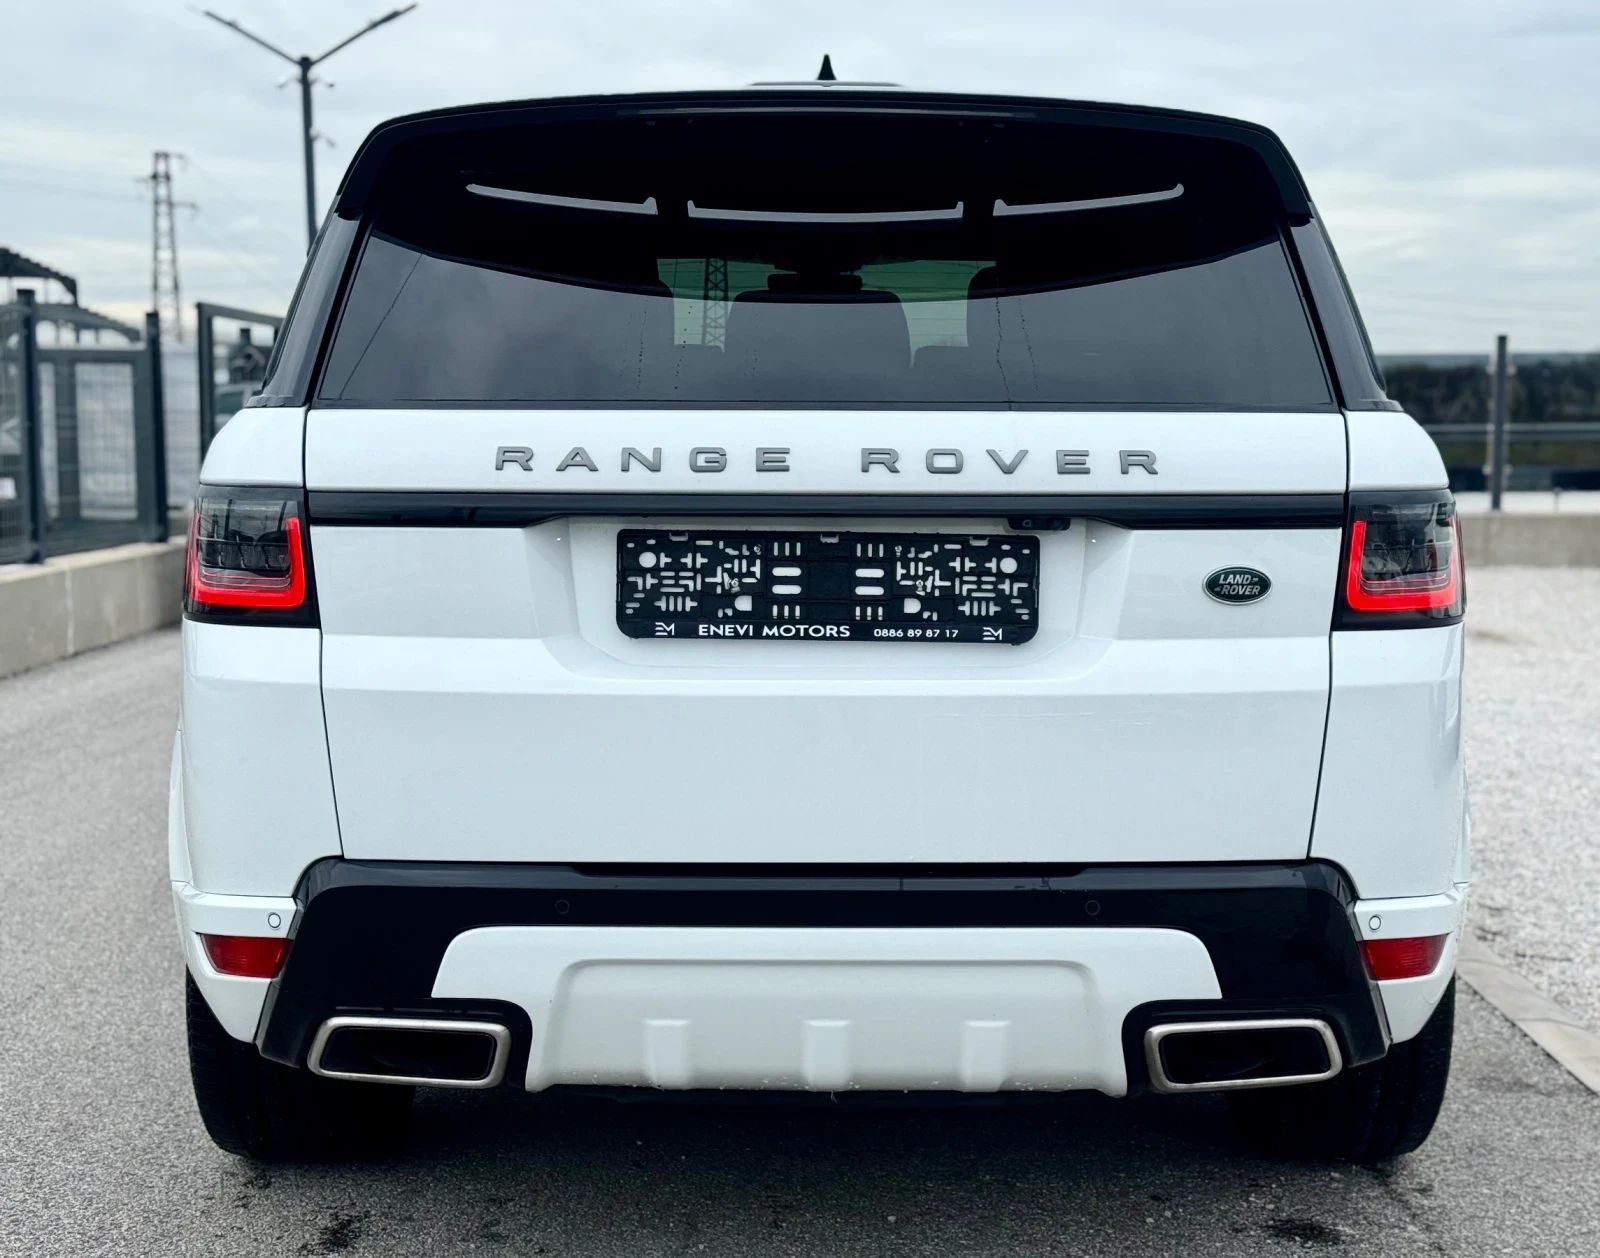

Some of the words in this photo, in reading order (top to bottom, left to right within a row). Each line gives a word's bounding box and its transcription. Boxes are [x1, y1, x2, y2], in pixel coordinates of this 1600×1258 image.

[495, 446, 791, 474] RANGE
[861, 447, 1159, 475] ROVER
[1221, 585, 1260, 595] ROVER
[698, 624, 754, 637] ENEVI
[762, 624, 851, 638] MOTORS
[873, 628, 904, 638] 0886
[907, 628, 923, 638] 89
[925, 629, 941, 638] 87
[945, 629, 959, 638] 17
